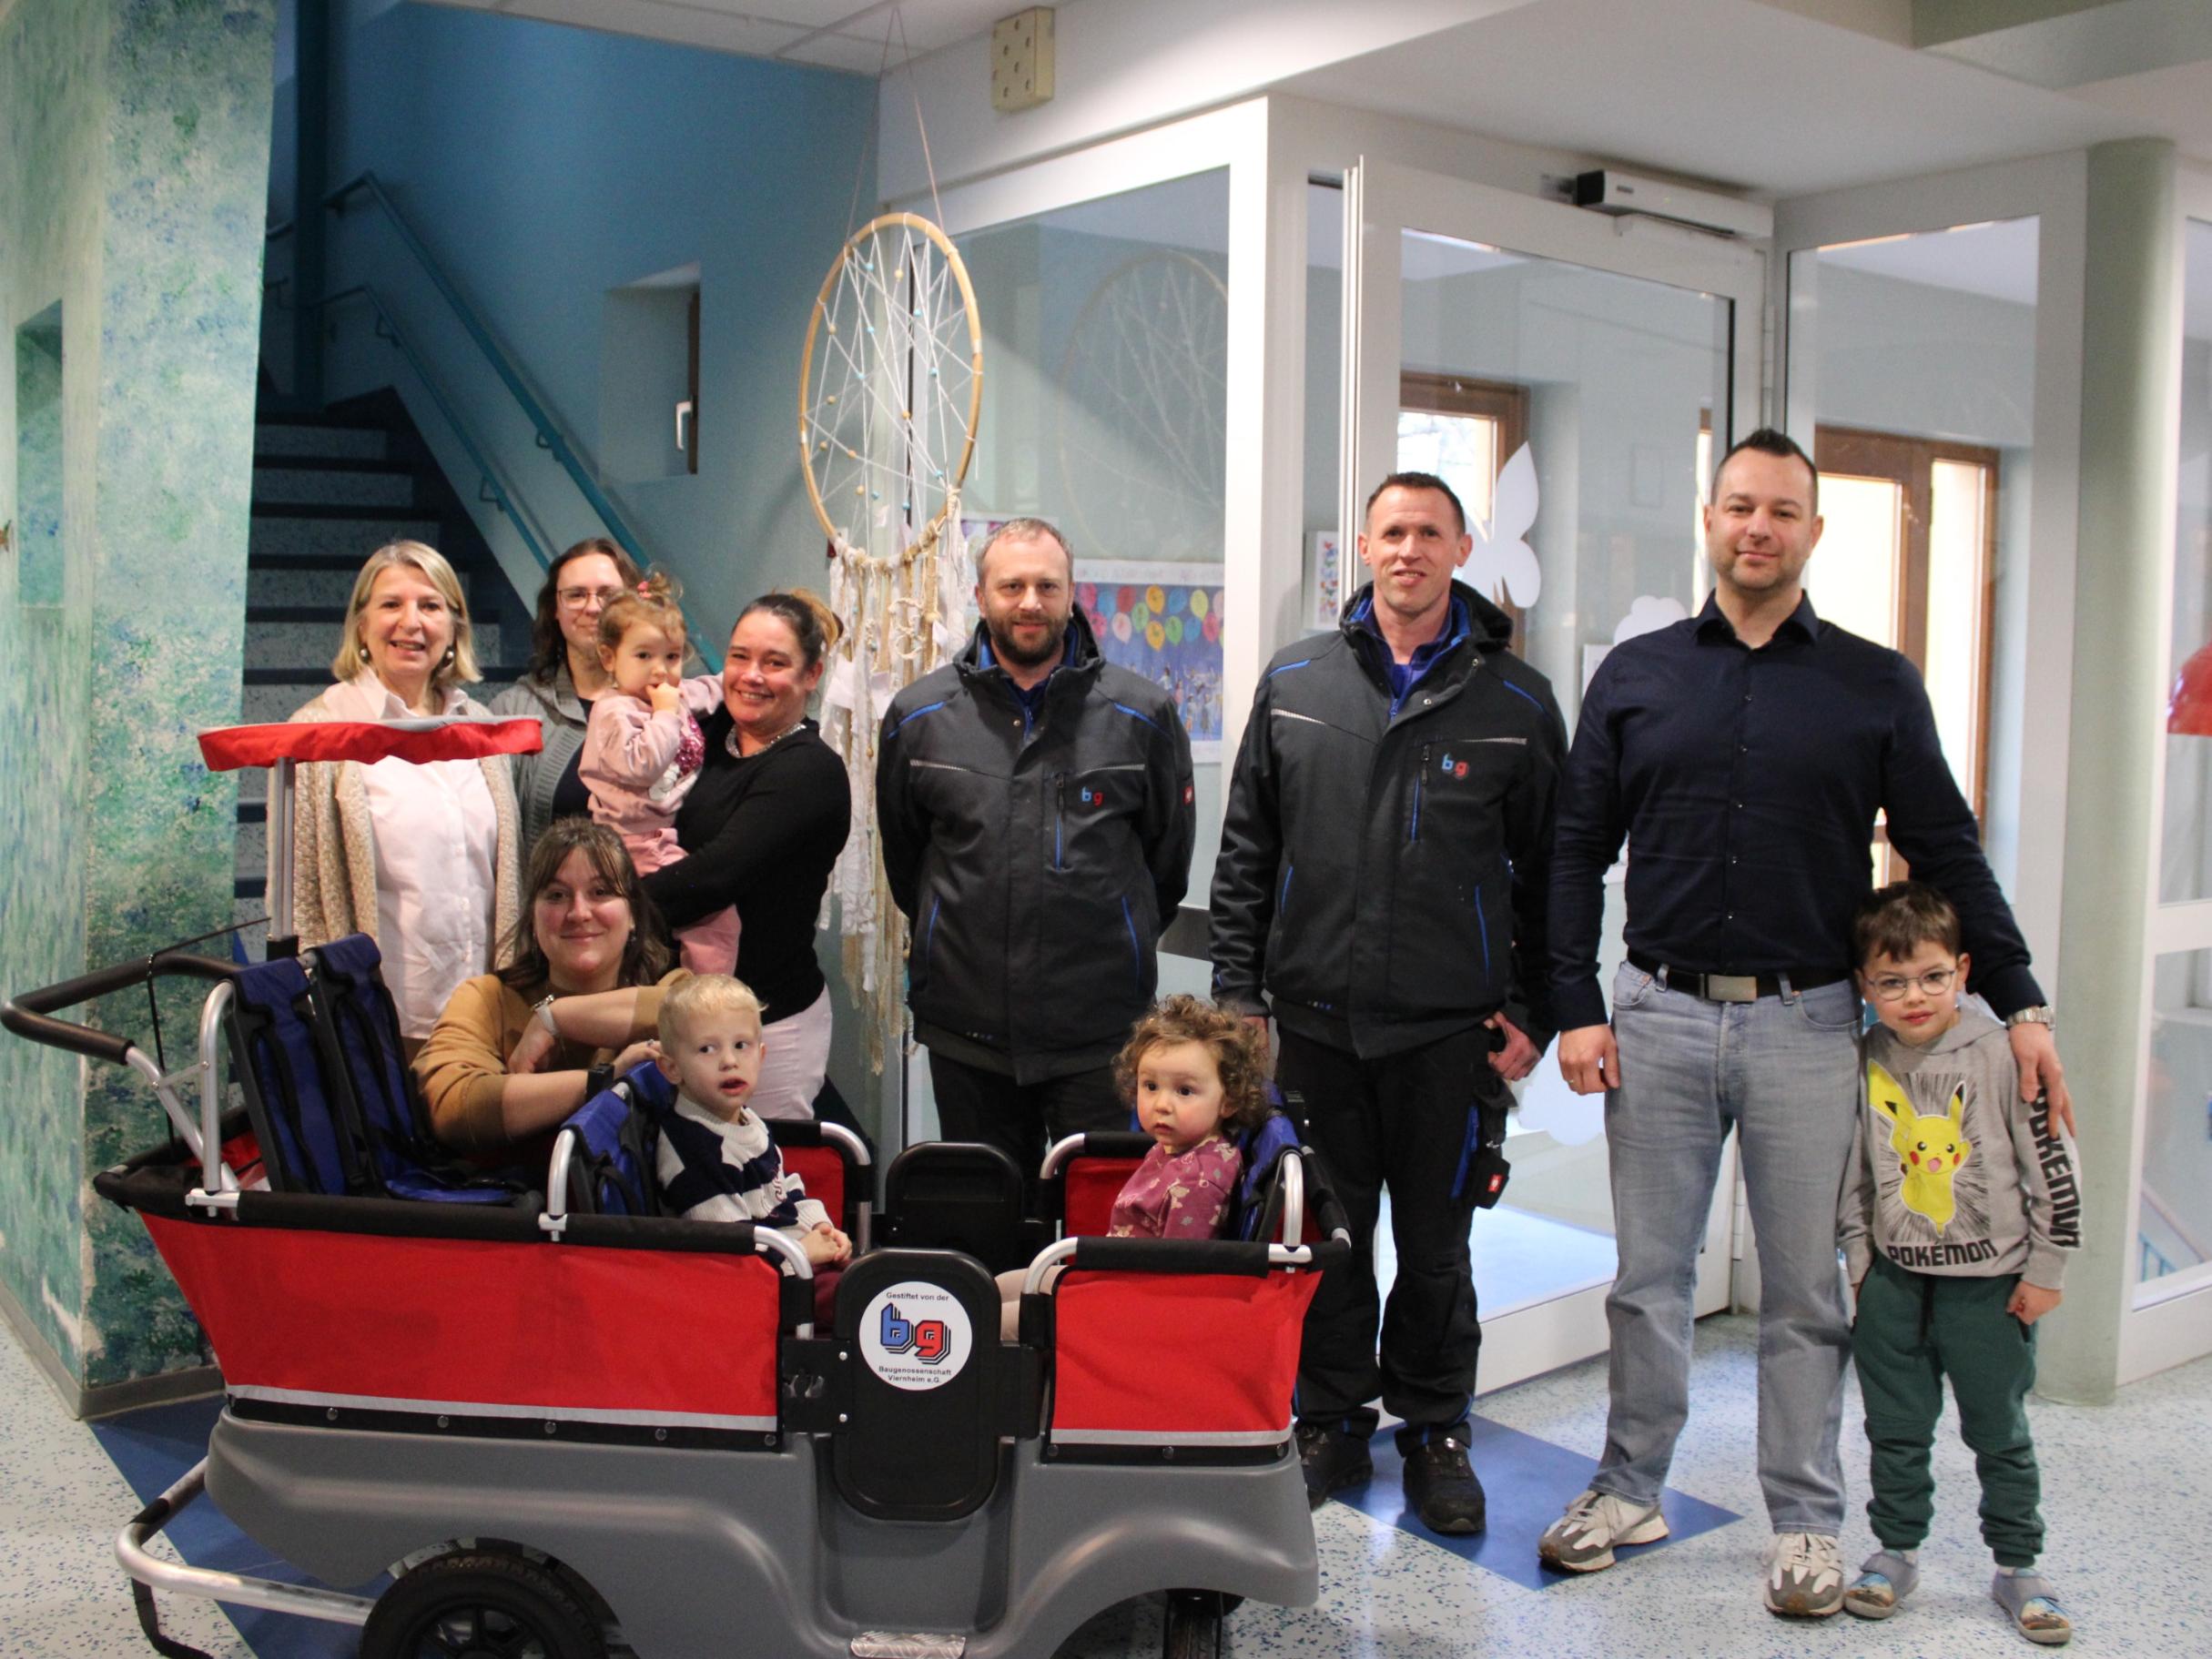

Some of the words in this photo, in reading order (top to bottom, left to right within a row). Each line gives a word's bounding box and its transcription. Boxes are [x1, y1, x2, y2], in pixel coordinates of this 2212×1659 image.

[886, 1291, 918, 1300] Gestiftet
[880, 1302, 951, 1364] bg
[878, 1365, 952, 1375] Baugenossenschaft
